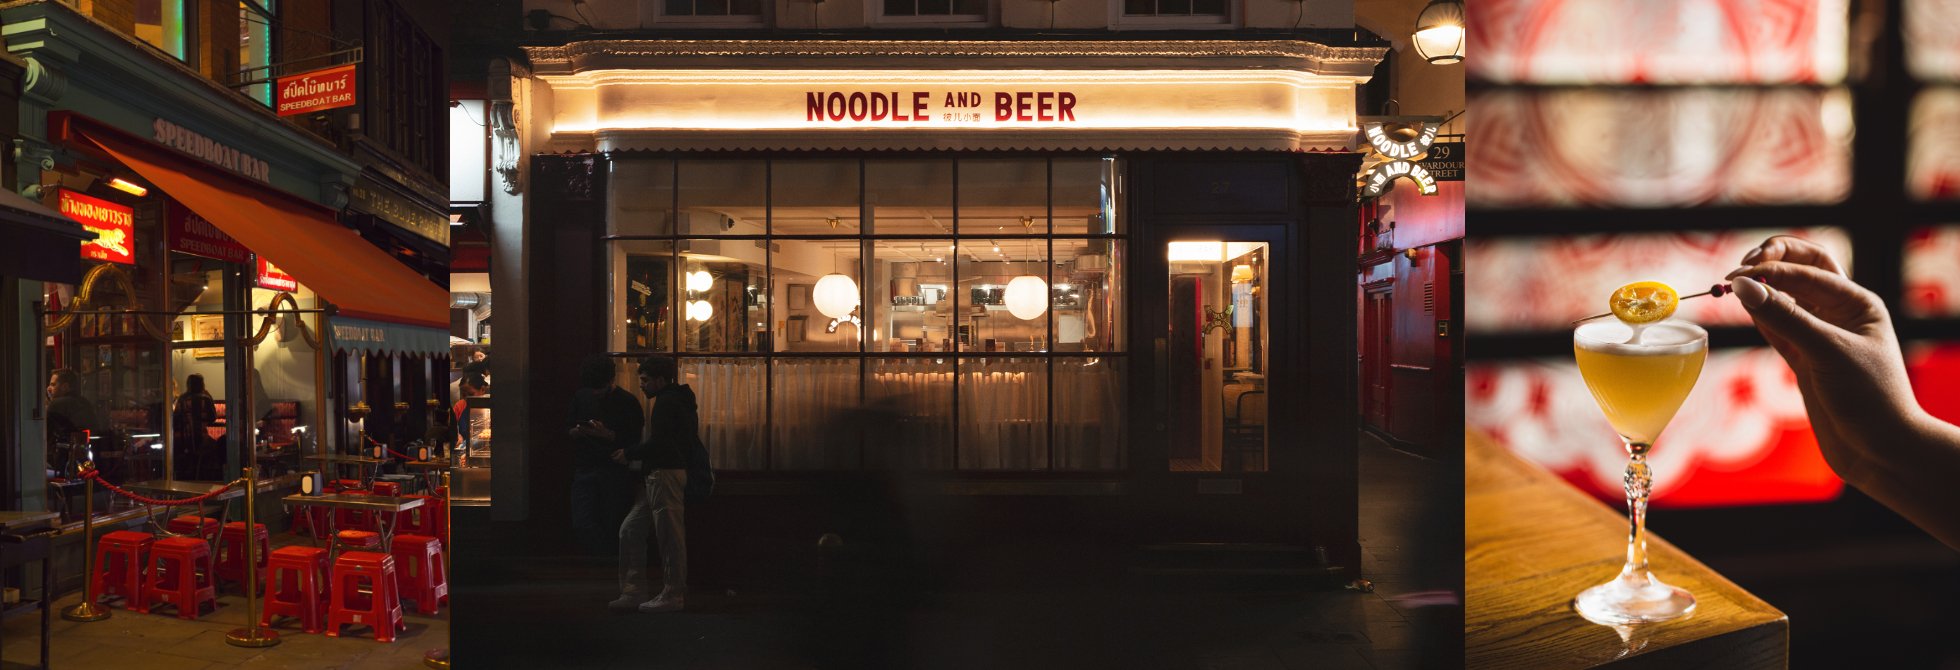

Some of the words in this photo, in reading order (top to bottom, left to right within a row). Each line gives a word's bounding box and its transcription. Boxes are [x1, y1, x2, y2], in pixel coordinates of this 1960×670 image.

[280, 96, 331, 112] SPEEDBOAT
[332, 93, 351, 103] BAR
[806, 91, 930, 122] NOODLE
[944, 91, 981, 108] AND
[995, 91, 1077, 122] BEER
[152, 117, 241, 171] SPEEDBOAT
[240, 153, 270, 184] BAR
[1368, 126, 1419, 158] NOODLE
[1434, 146, 1450, 159] 29
[1385, 161, 1411, 177] AND
[1410, 164, 1437, 195] BEER
[1429, 169, 1459, 178] TREET
[370, 191, 390, 214] THE
[179, 237, 226, 257] SPEEDBOAT
[227, 249, 244, 260] BAR
